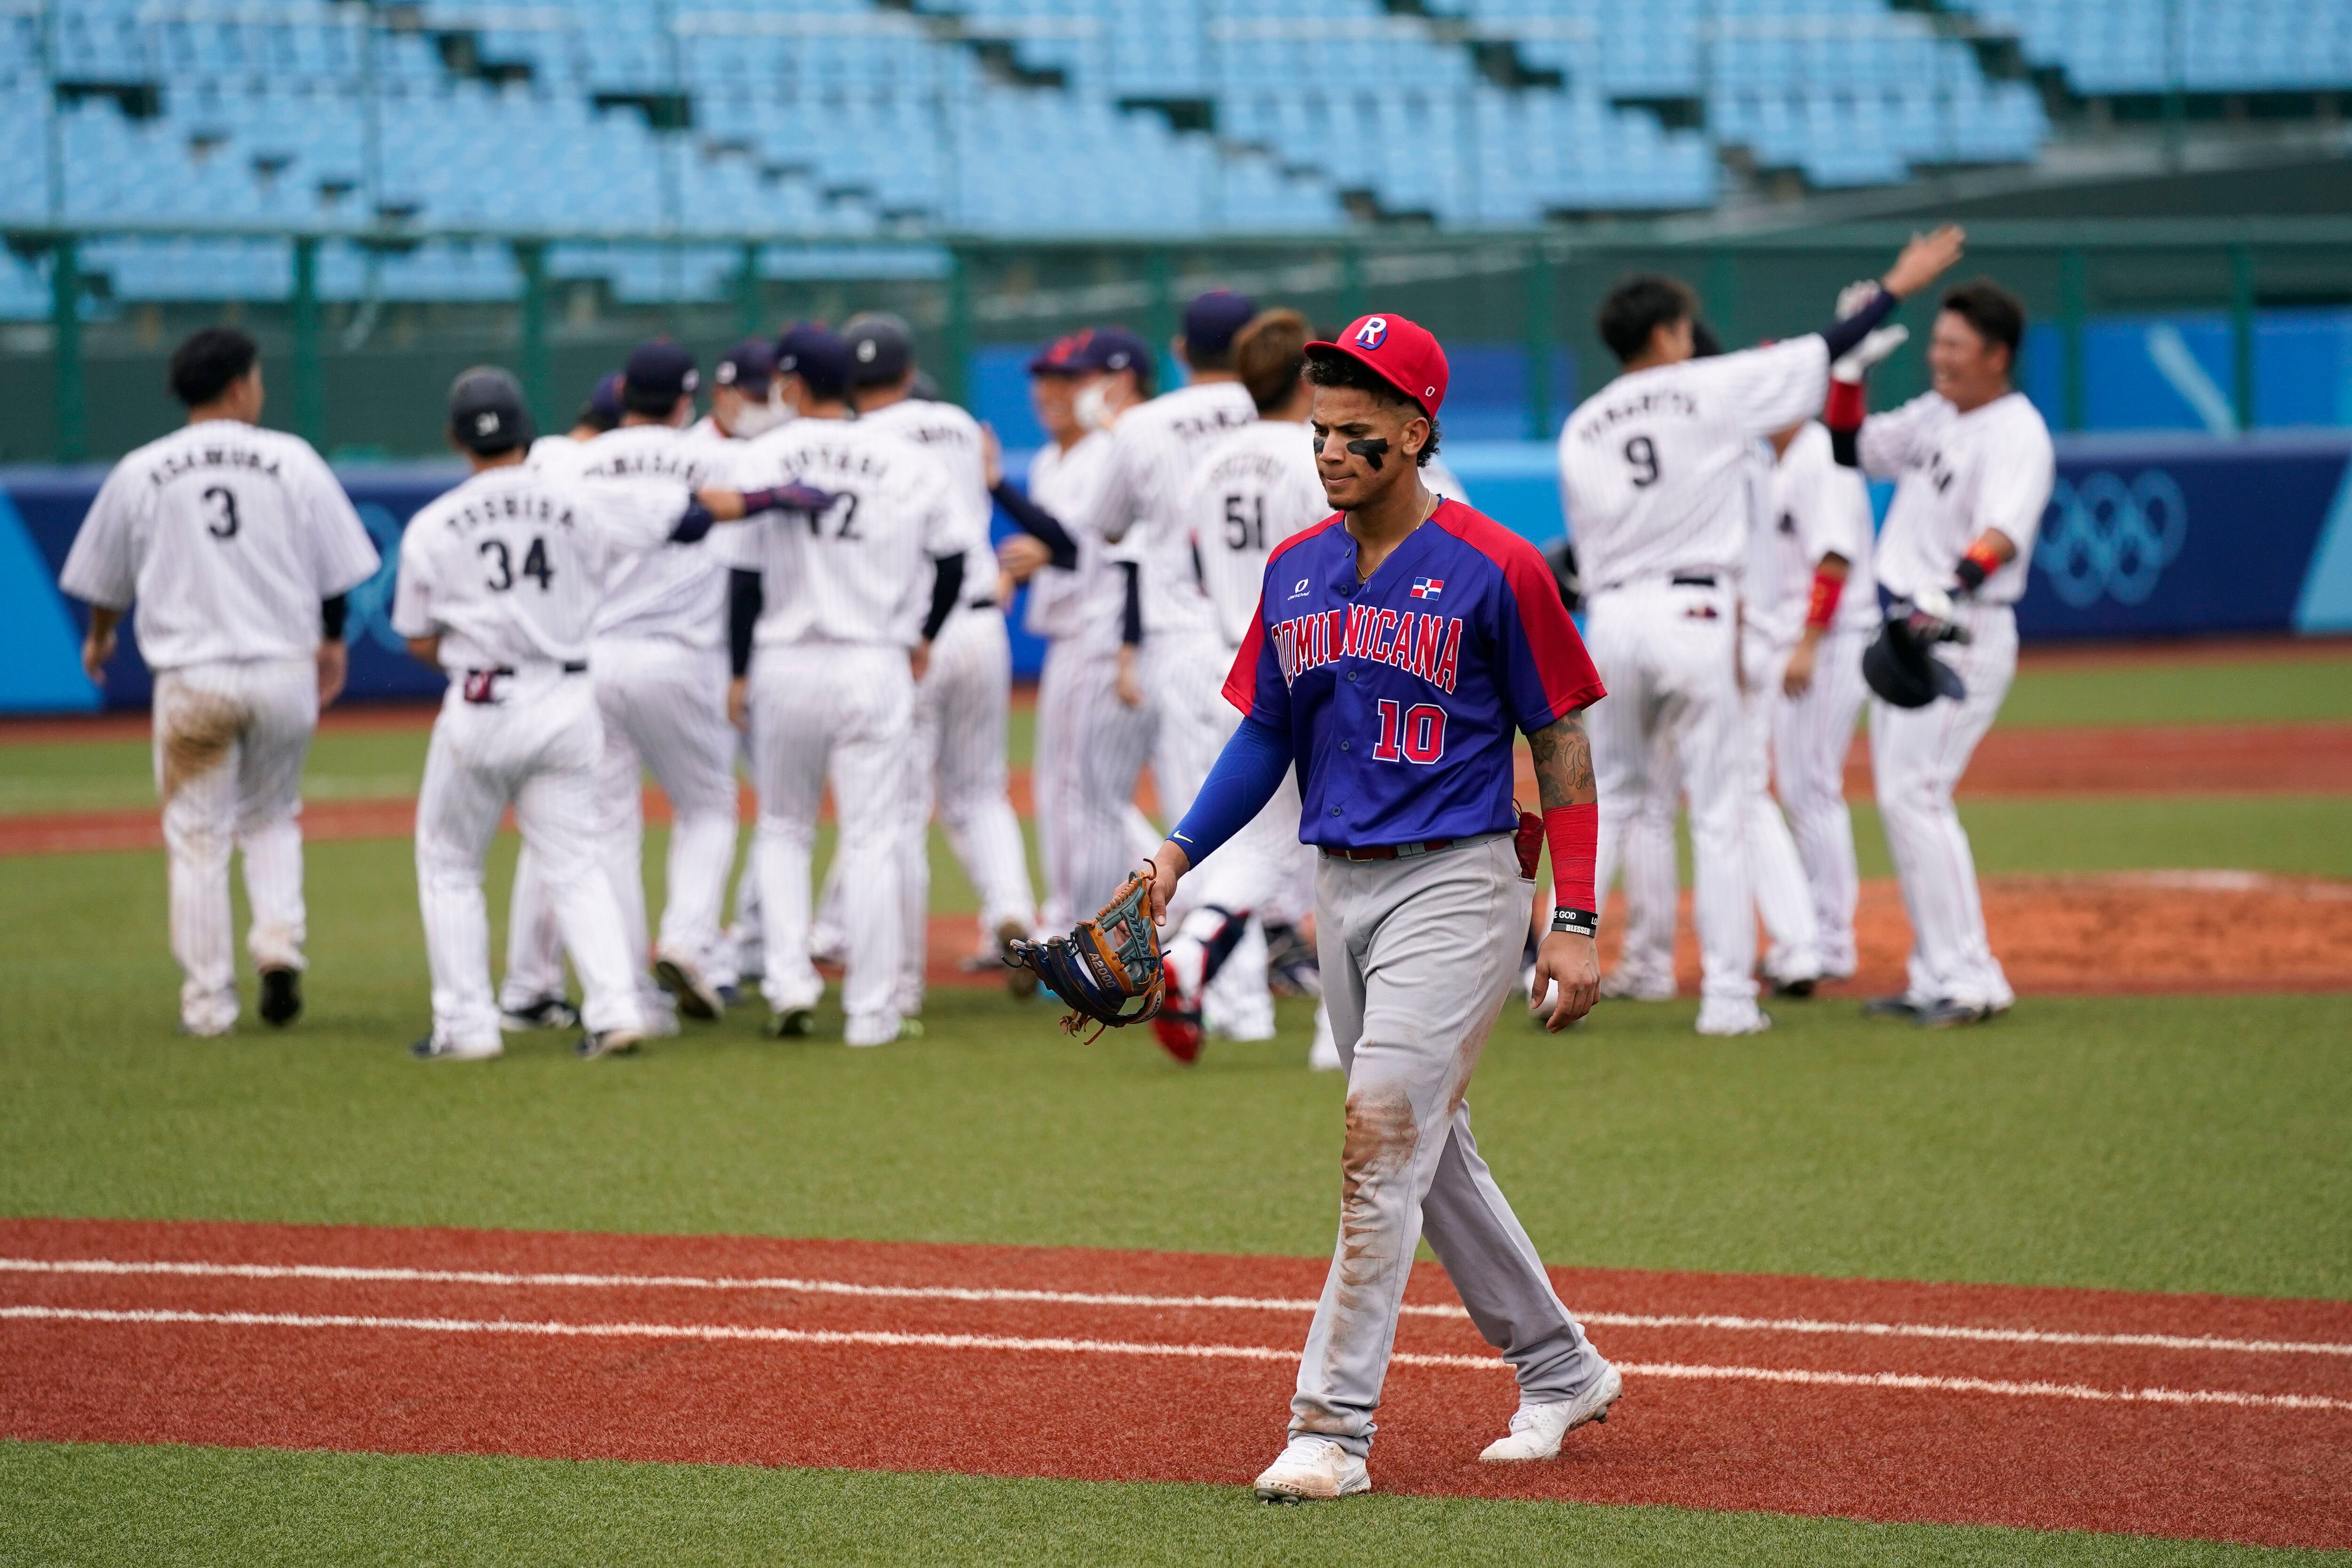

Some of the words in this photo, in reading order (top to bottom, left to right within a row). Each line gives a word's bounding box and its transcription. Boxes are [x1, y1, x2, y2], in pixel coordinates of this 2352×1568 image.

[1625, 436, 1660, 487] 9
[203, 487, 239, 539] 3
[1224, 495, 1264, 551] 51
[480, 537, 556, 592] 34
[1271, 603, 1463, 696] DOMINICANA
[1373, 699, 1448, 764] 10
[1559, 911, 1576, 920] GOD
[1565, 924, 1590, 935] BLESSED
[1088, 953, 1116, 988] A2000
